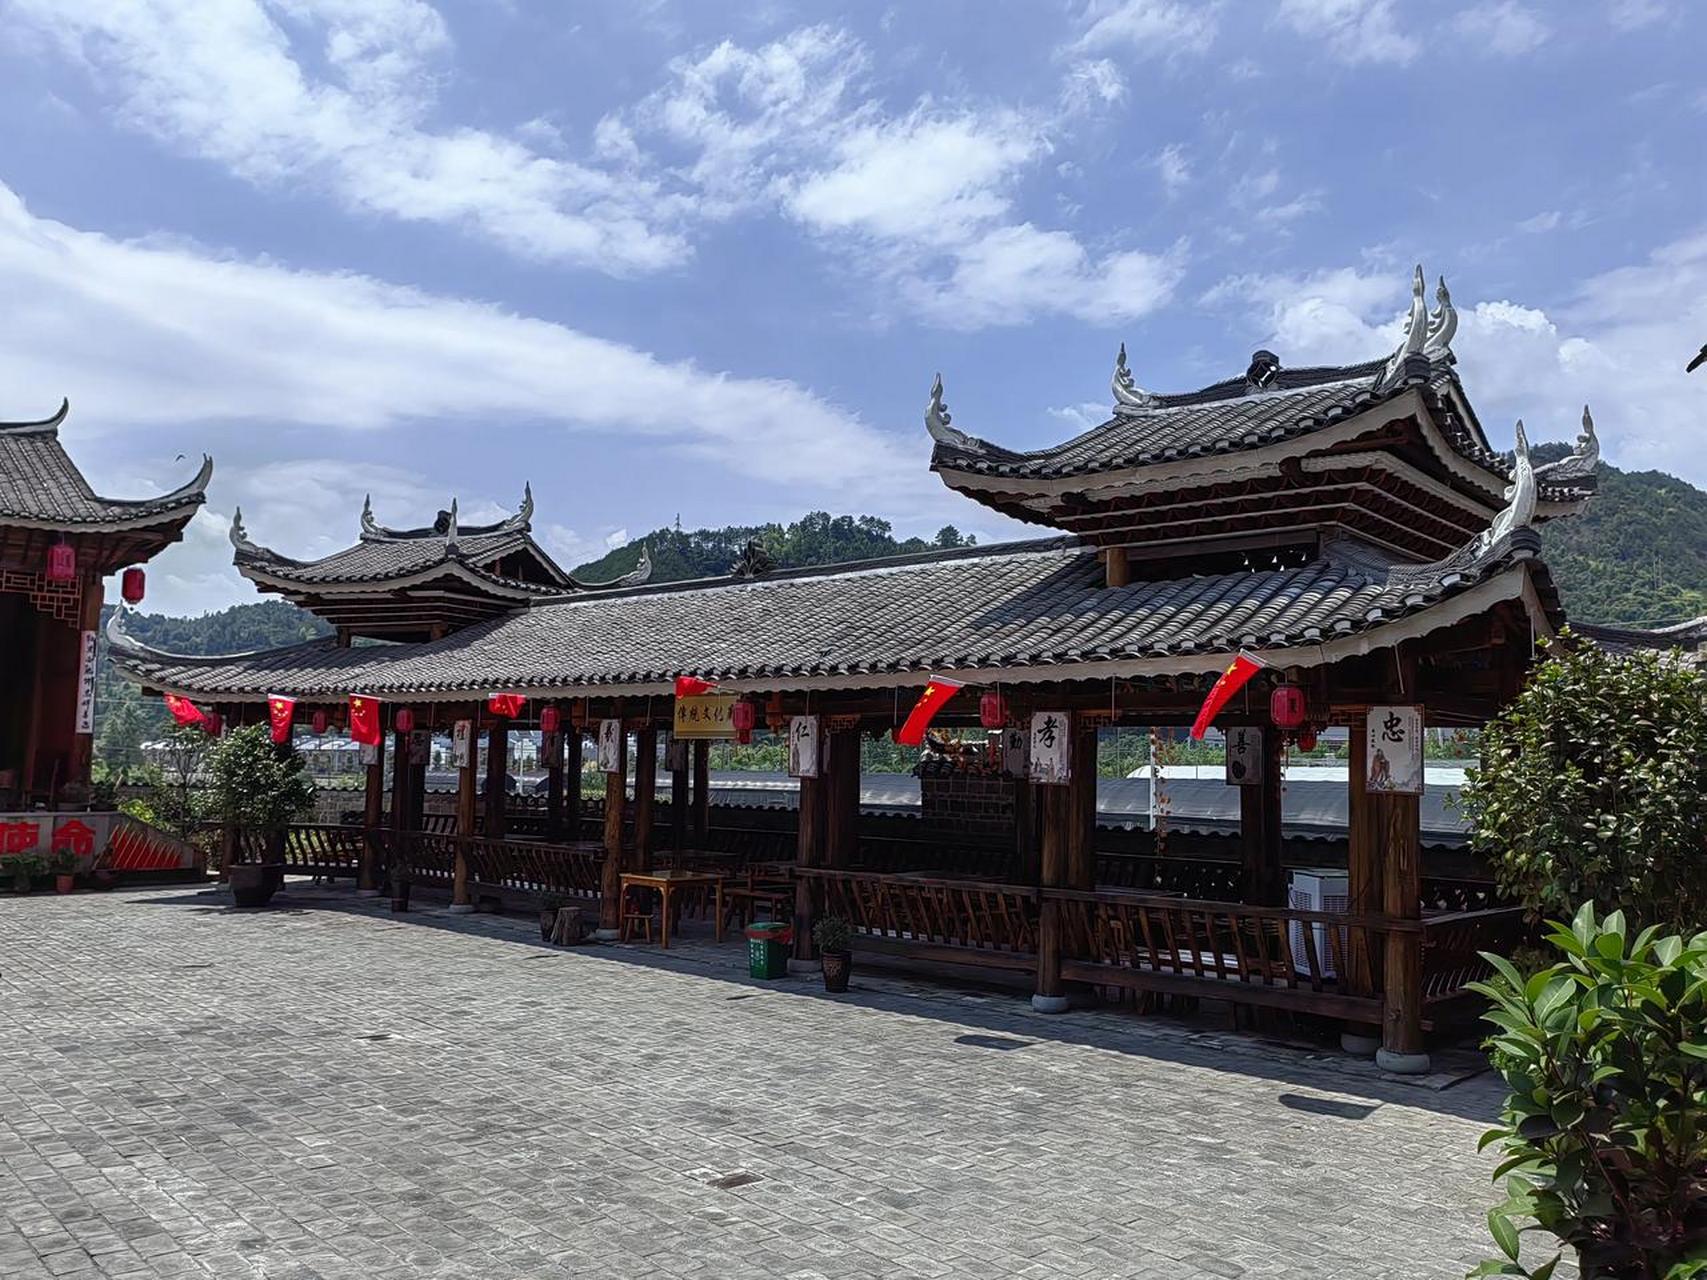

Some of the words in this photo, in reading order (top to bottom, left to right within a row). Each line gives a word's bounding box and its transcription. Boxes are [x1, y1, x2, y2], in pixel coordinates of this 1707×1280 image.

[796, 722, 809, 742] 仁
[1037, 716, 1058, 748] 孝
[1383, 711, 1405, 742] 忠
